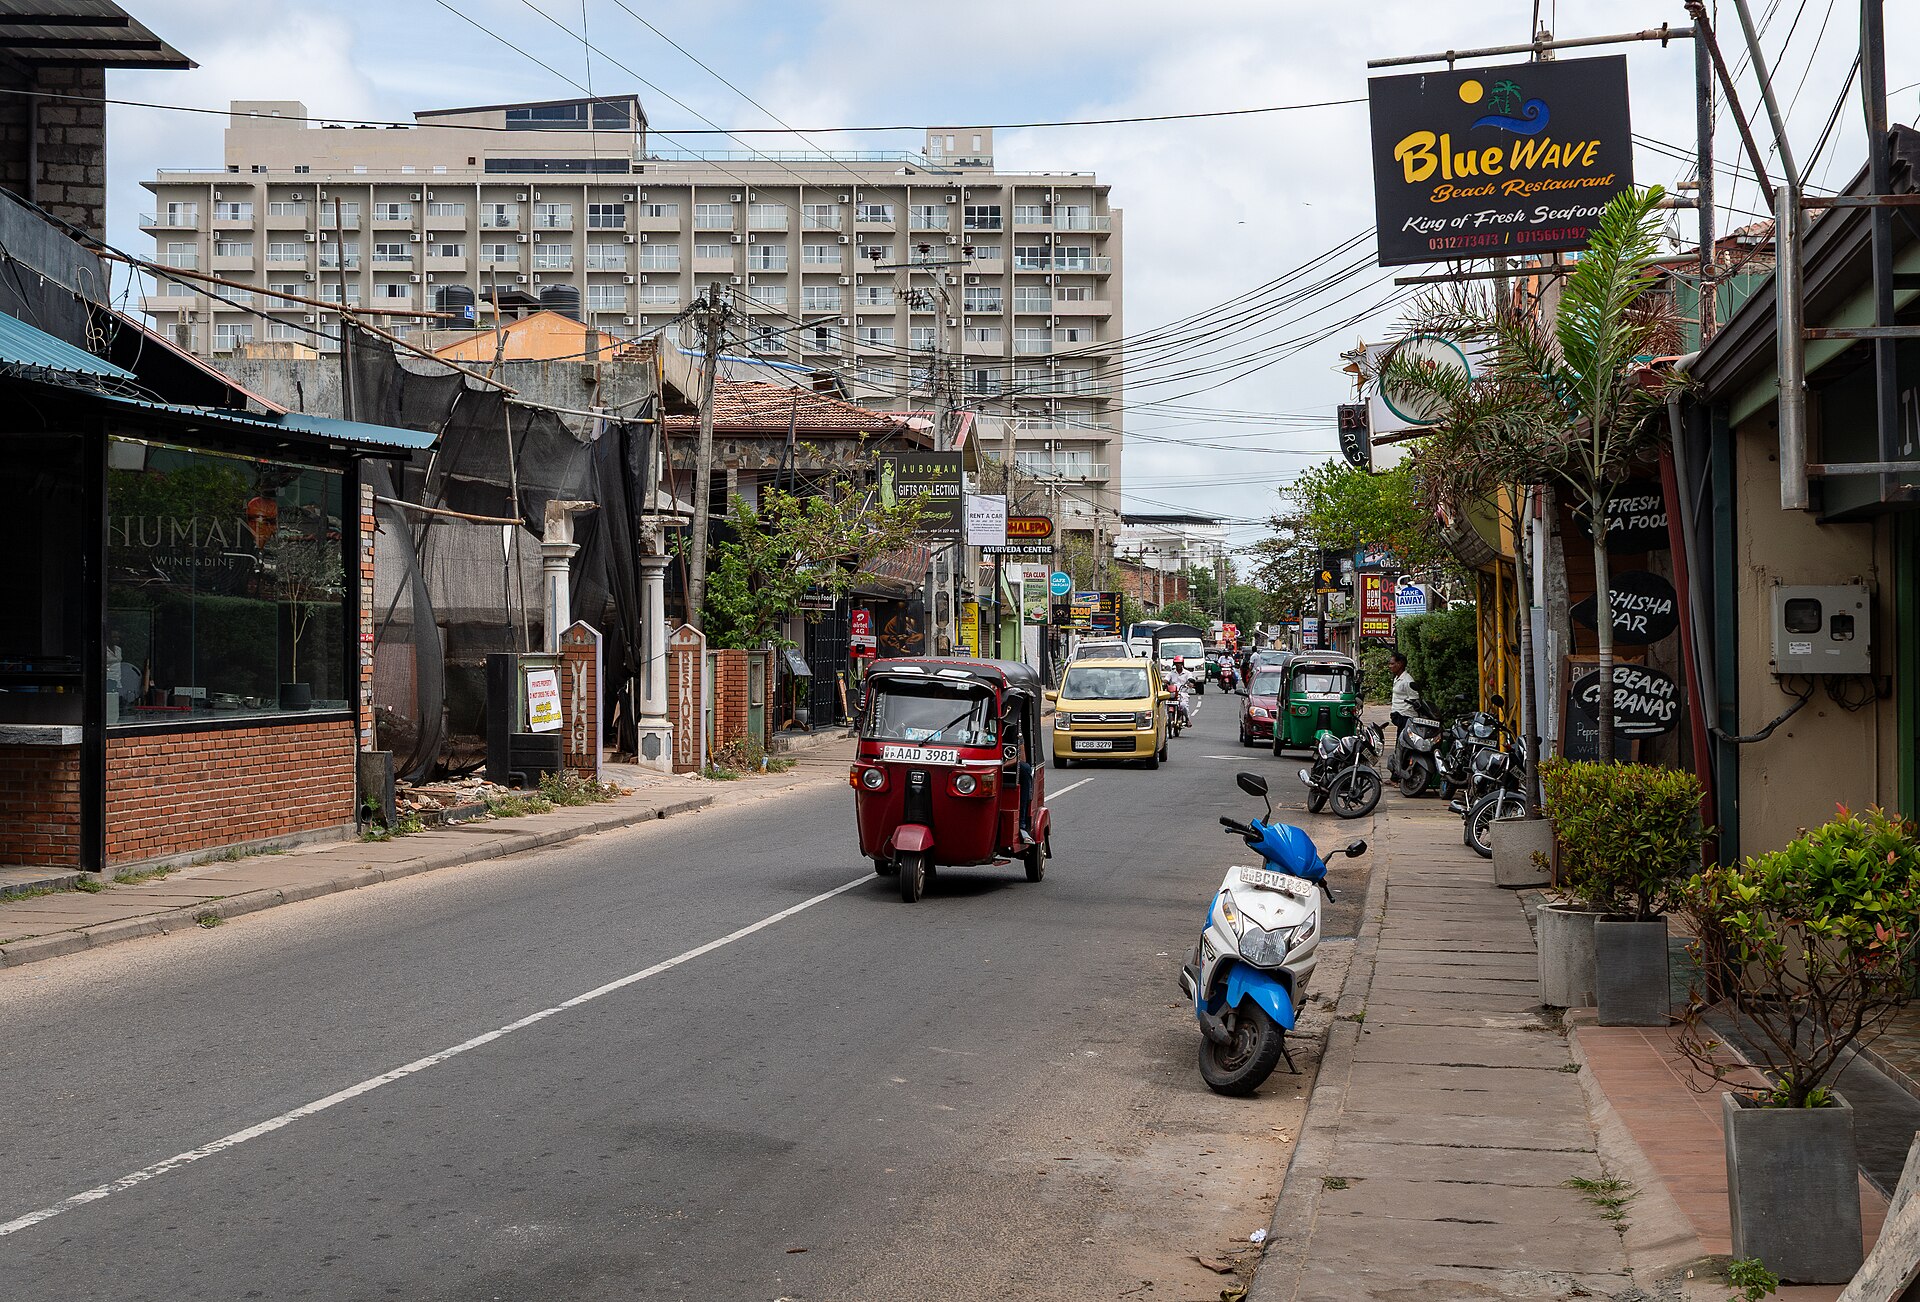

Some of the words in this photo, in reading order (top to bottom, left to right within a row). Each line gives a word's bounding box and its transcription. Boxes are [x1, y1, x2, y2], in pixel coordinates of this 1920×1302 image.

[1394, 130, 1504, 184] Blue
[1509, 136, 1601, 171] WAVE
[1430, 182, 1497, 203] Beach
[1501, 172, 1615, 197] Restaurant
[1401, 216, 1446, 234] King
[1450, 213, 1471, 228] of
[1473, 209, 1526, 229] Fresh
[1429, 232, 1499, 250] 0312273473
[1516, 225, 1587, 244] 0715667192
[898, 484, 918, 496] GIFTS
[918, 484, 960, 496] COLECTION
[1607, 495, 1660, 514] FRESH
[106, 515, 262, 548] HUMAN
[155, 556, 191, 567] WINE
[194, 558, 202, 567] &
[204, 557, 235, 568] DINE
[821, 593, 833, 601] Food
[1400, 597, 1423, 605] AWAY
[1612, 667, 1675, 699] BEACH
[574, 660, 586, 754] VILLAGE
[681, 651, 691, 764] RESTAURANT
[1582, 684, 1677, 721] CBANAS
[566, 754, 595, 768] INN
[896, 748, 920, 760] AAD
[925, 749, 955, 762] 3981
